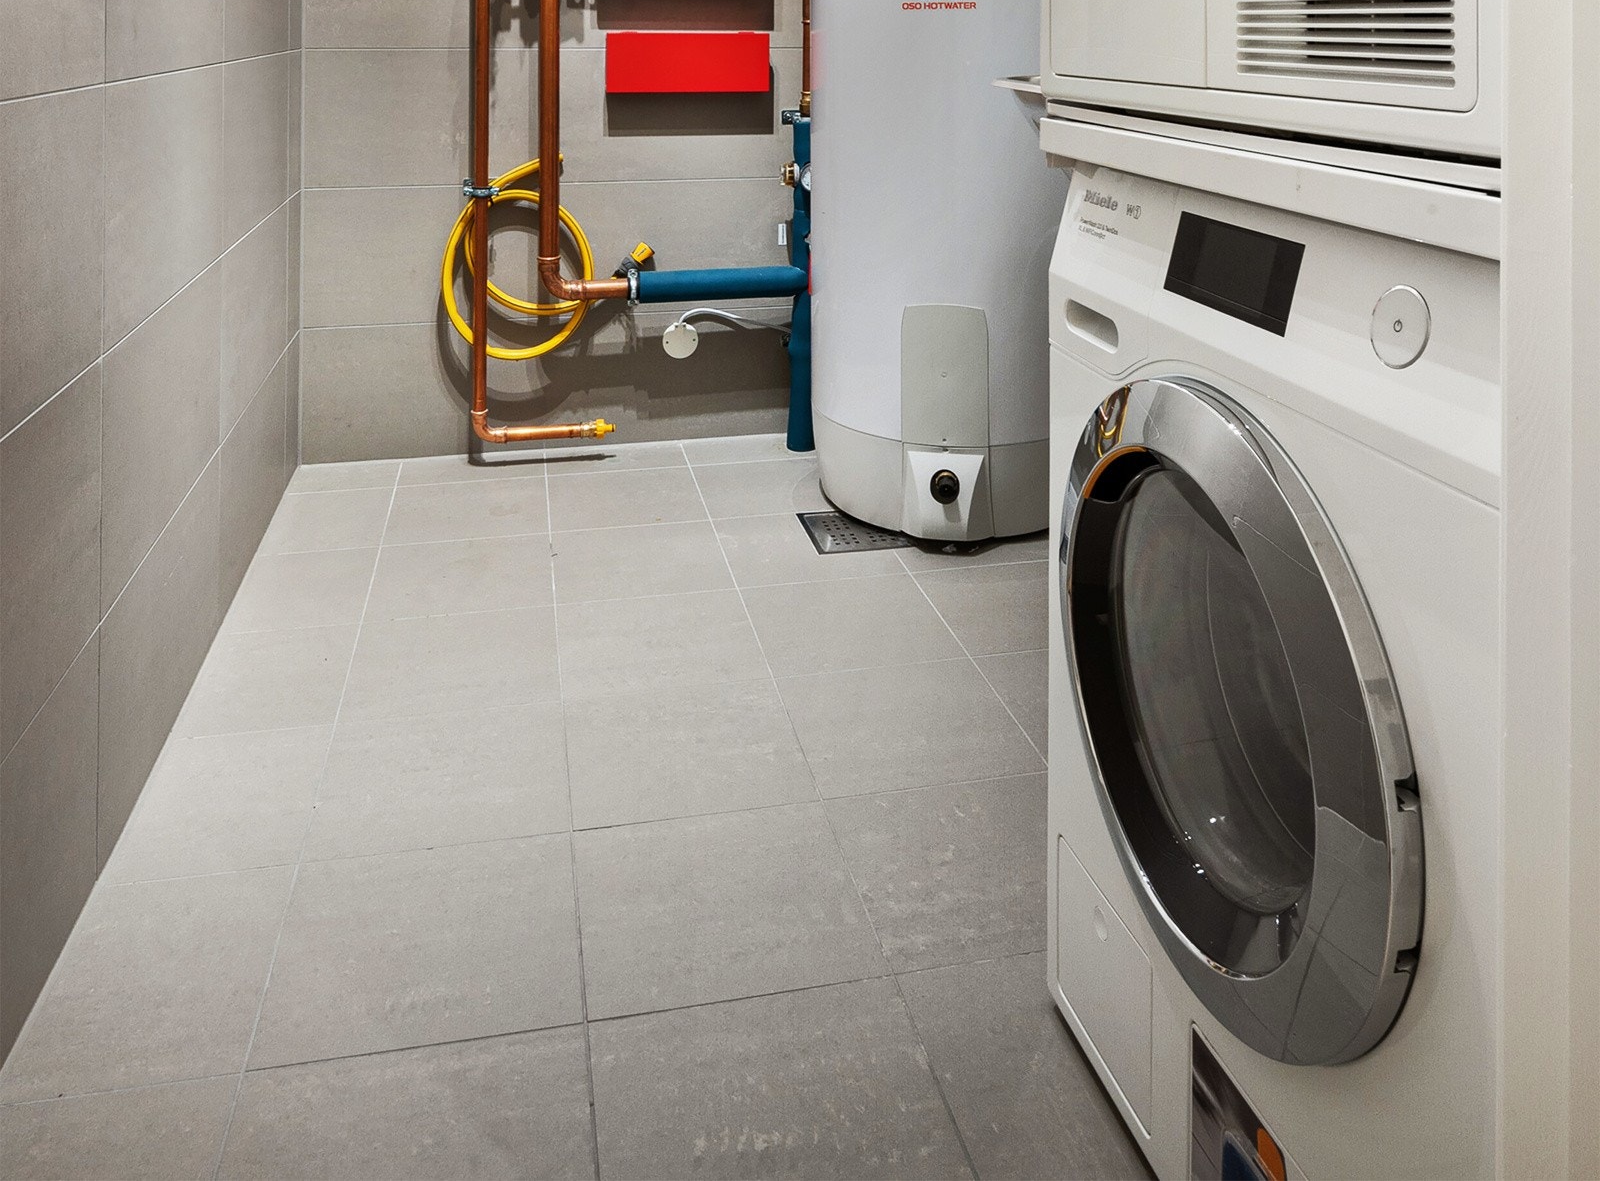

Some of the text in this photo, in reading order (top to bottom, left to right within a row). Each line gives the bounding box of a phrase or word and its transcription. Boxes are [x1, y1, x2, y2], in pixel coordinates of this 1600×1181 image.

[901, 1, 977, 11] OSO HOTWATER
[1083, 189, 1118, 211] Miele
